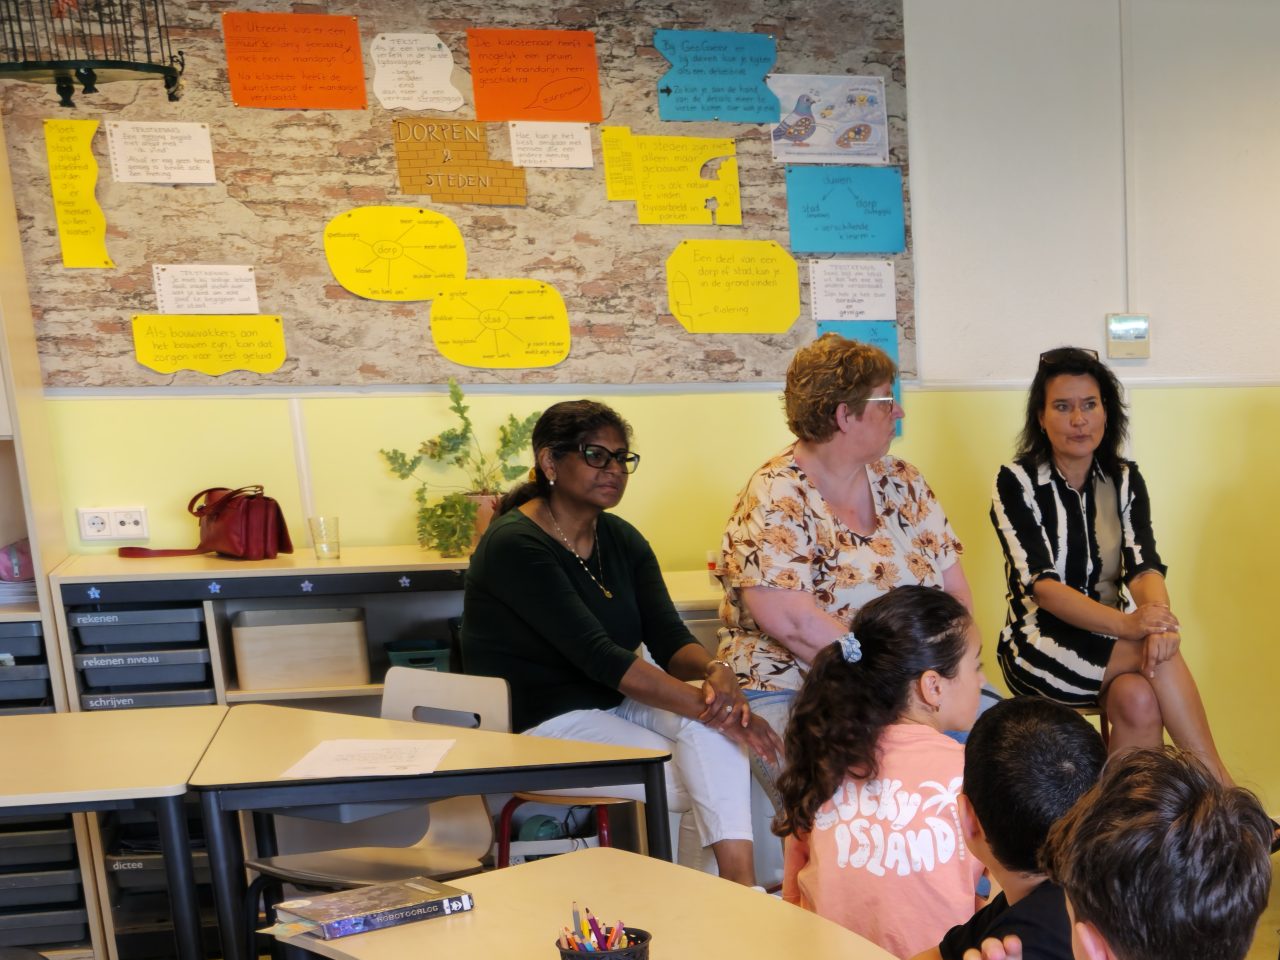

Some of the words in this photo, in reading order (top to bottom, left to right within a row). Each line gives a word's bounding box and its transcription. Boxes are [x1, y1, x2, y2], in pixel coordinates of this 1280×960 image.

[247, 20, 288, 33] Utrecht
[469, 34, 491, 47] De
[546, 53, 573, 63] pruim
[479, 66, 498, 74] over
[515, 65, 560, 75] mandarijn
[396, 121, 481, 142] DORPEN
[653, 141, 688, 151] steden
[641, 152, 669, 162] alleen
[425, 173, 490, 188] STEDEN
[801, 202, 821, 213] stad
[856, 199, 878, 210] dorp
[377, 245, 398, 256] dorp
[693, 249, 712, 263] Een
[715, 255, 735, 264] deel
[740, 256, 755, 264] van
[760, 256, 777, 264] een
[698, 267, 719, 278] dorp
[721, 266, 730, 276] of
[755, 267, 770, 275] kan
[725, 280, 749, 292] grond
[146, 326, 167, 338] Als
[170, 326, 236, 338] bouwvakkers
[240, 329, 259, 338] aan
[152, 341, 169, 351] het
[236, 340, 256, 348] kan
[257, 340, 274, 348] dat
[153, 354, 188, 366] zorgen
[77, 613, 118, 624] rekenen
[83, 657, 124, 667] rekenen
[127, 655, 159, 665] niveau
[89, 696, 134, 708] schrijven
[835, 817, 956, 877] ISLAND
[113, 861, 144, 870] dictee
[375, 904, 440, 923] ROBOTOORLOG
